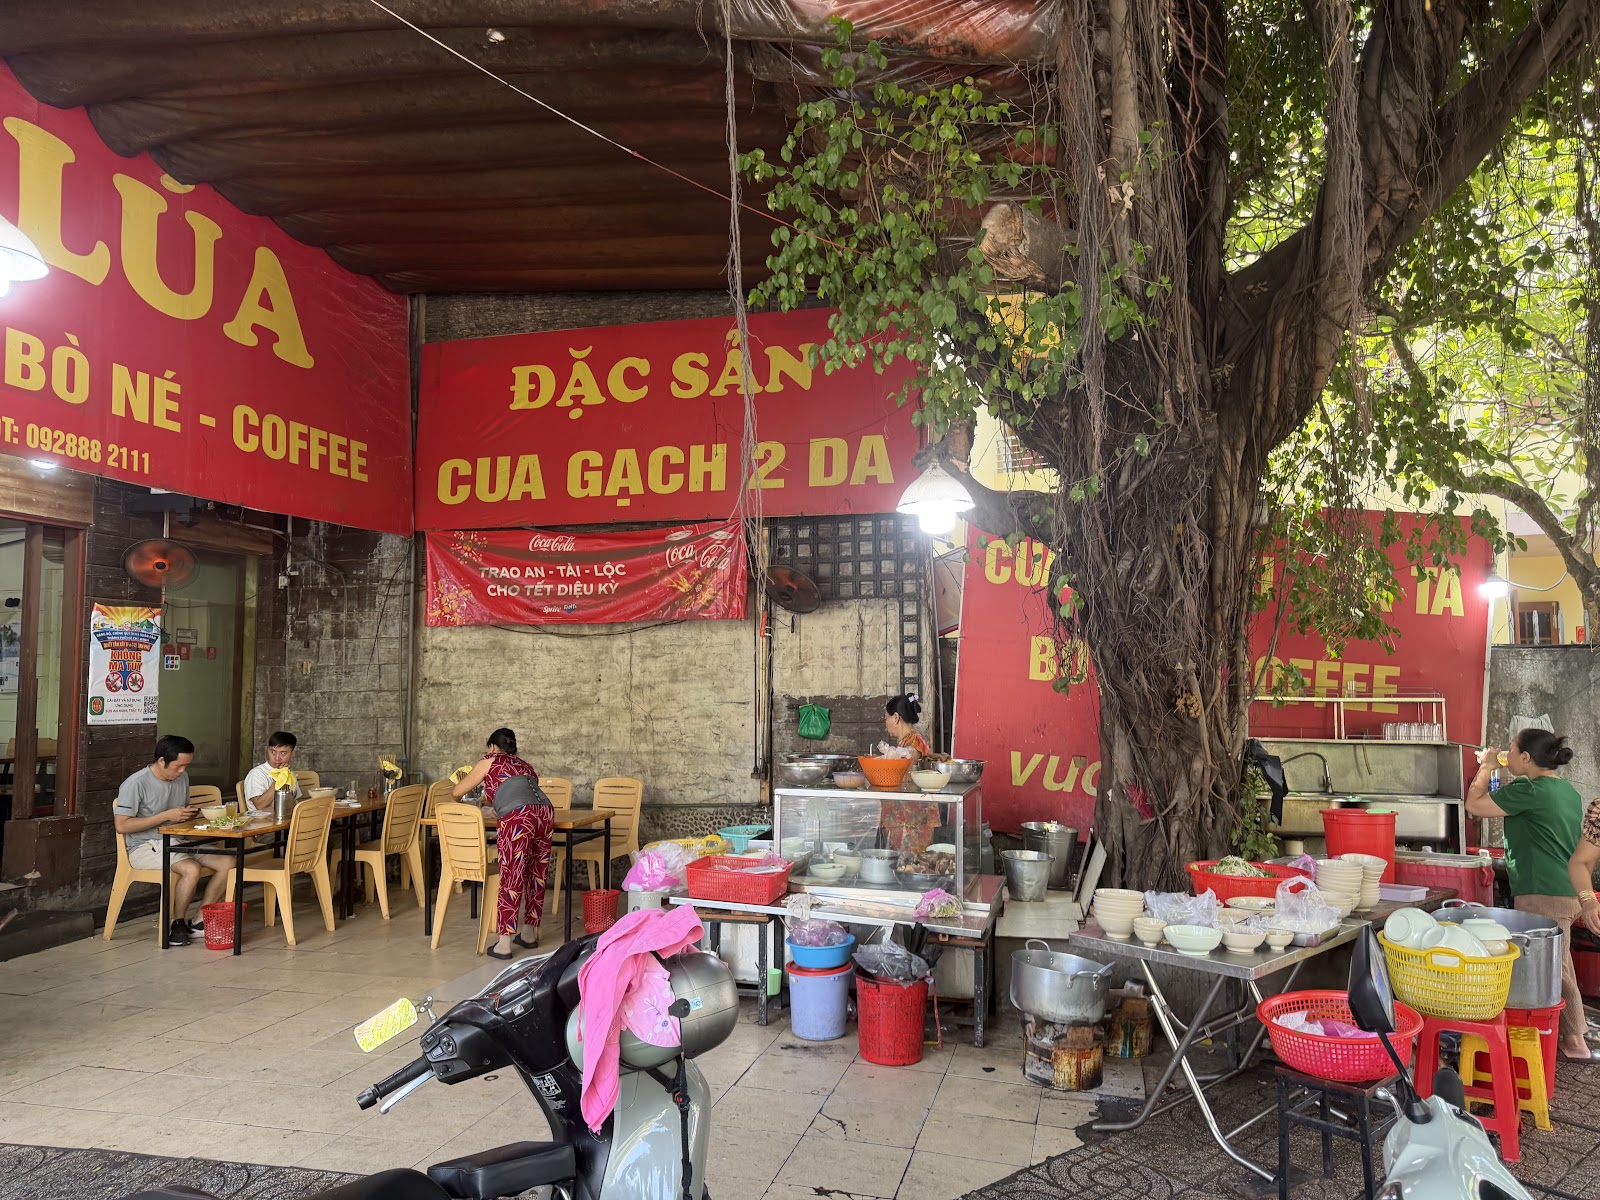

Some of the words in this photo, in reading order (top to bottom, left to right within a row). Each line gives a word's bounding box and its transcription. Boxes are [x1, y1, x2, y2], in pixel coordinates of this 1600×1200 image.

[509, 344, 652, 420] ĐẶC
[670, 328, 816, 400] SẢN
[4, 326, 90, 405] BÒ
[111, 370, 182, 433] NÉ
[232, 404, 370, 483] COFFEE
[0, 415, 19, 445] T:
[26, 423, 102, 463] 092888
[107, 443, 150, 475] 2111
[436, 453, 547, 505] CUA
[566, 442, 728, 507] GẠCH
[748, 440, 787, 490] 2
[807, 434, 895, 488] DA
[479, 566, 521, 579] TRAO
[524, 565, 545, 578] AN
[557, 563, 581, 578] TÀI
[594, 562, 627, 578] LỘC
[486, 584, 521, 598] CHO
[523, 578, 554, 597] TẾT
[557, 580, 596, 599] DIỆU
[597, 578, 619, 596] KỲ
[109, 661, 124, 671] MA
[111, 649, 142, 660] KHÔNG
[1246, 655, 1402, 714] OFFEE
